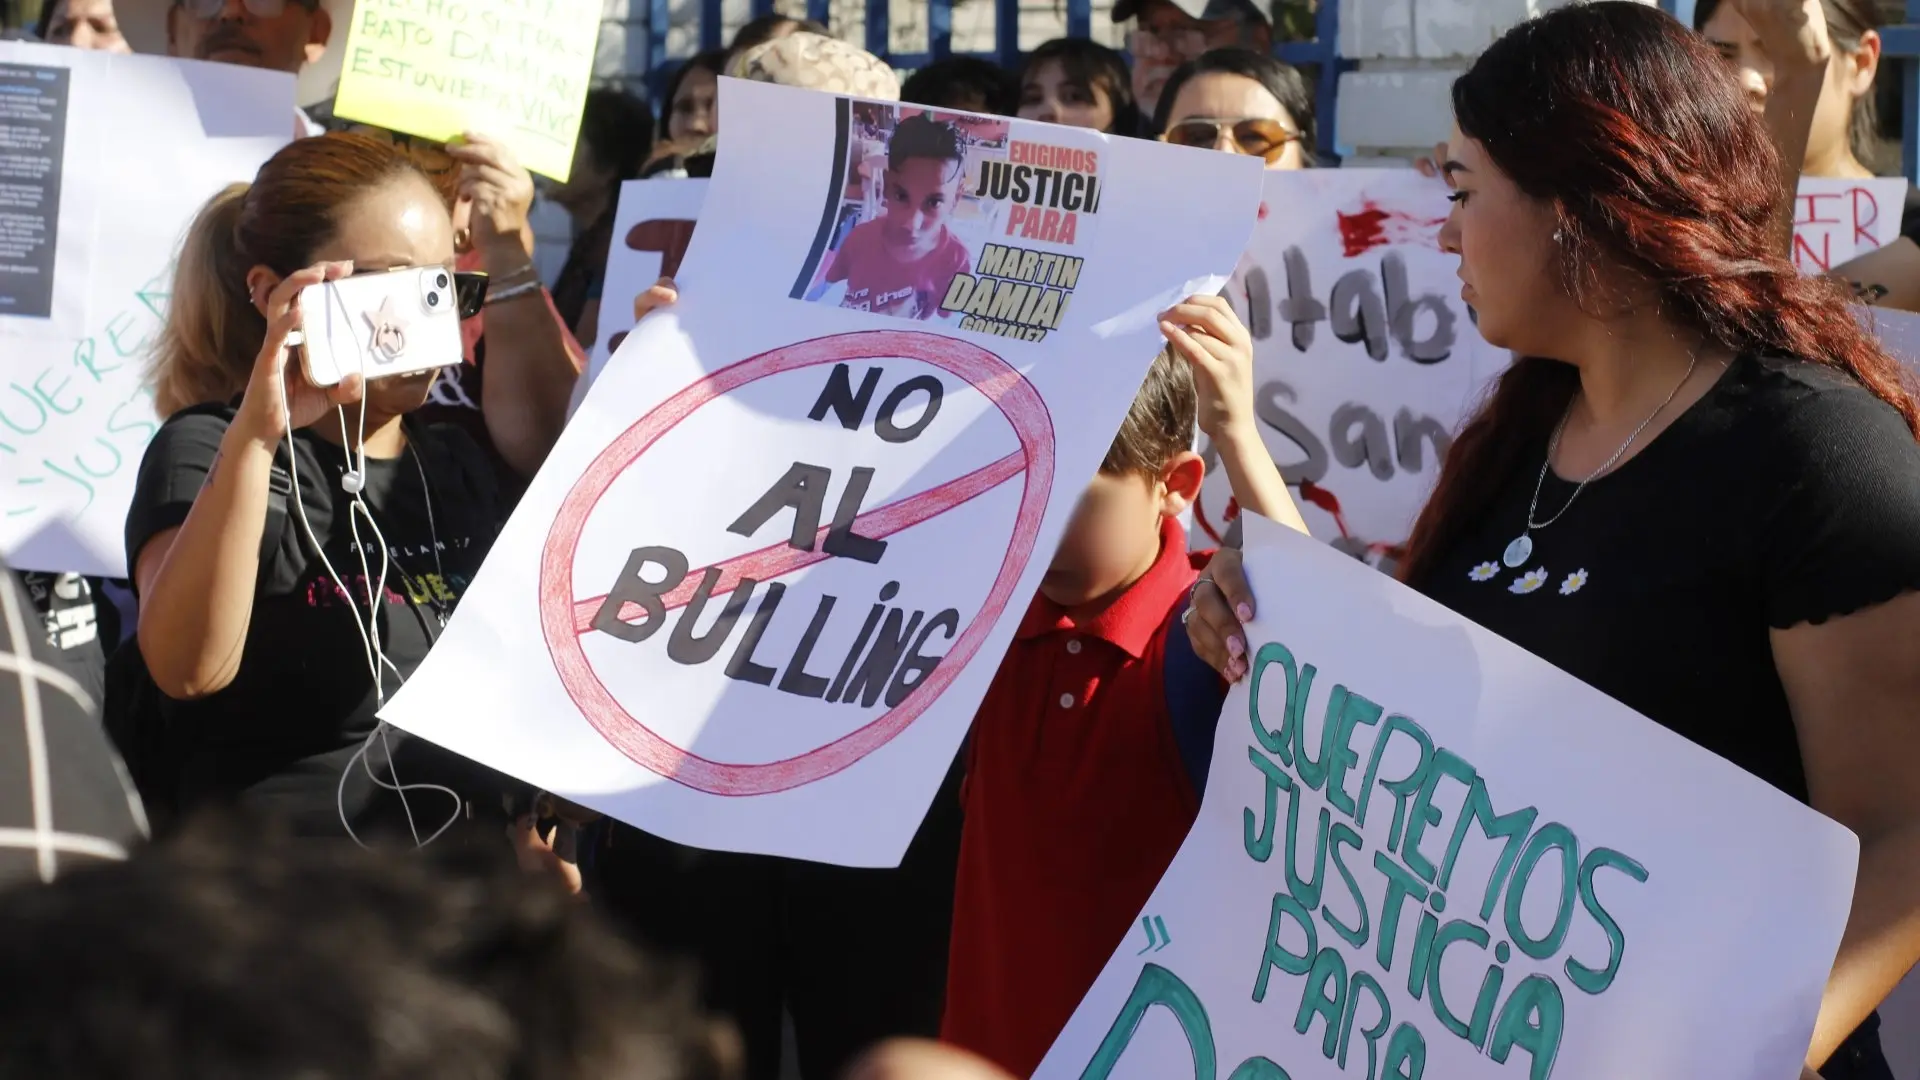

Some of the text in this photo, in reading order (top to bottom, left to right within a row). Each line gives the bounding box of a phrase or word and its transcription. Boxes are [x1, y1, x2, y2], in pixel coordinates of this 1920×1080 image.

[1009, 140, 1097, 174] EXIGIMOS
[1005, 205, 1078, 245] PARA
[976, 243, 1084, 290] MARTIN
[807, 362, 945, 444] NO
[726, 461, 889, 565] AL
[1247, 640, 1650, 996] QUEREMOS
